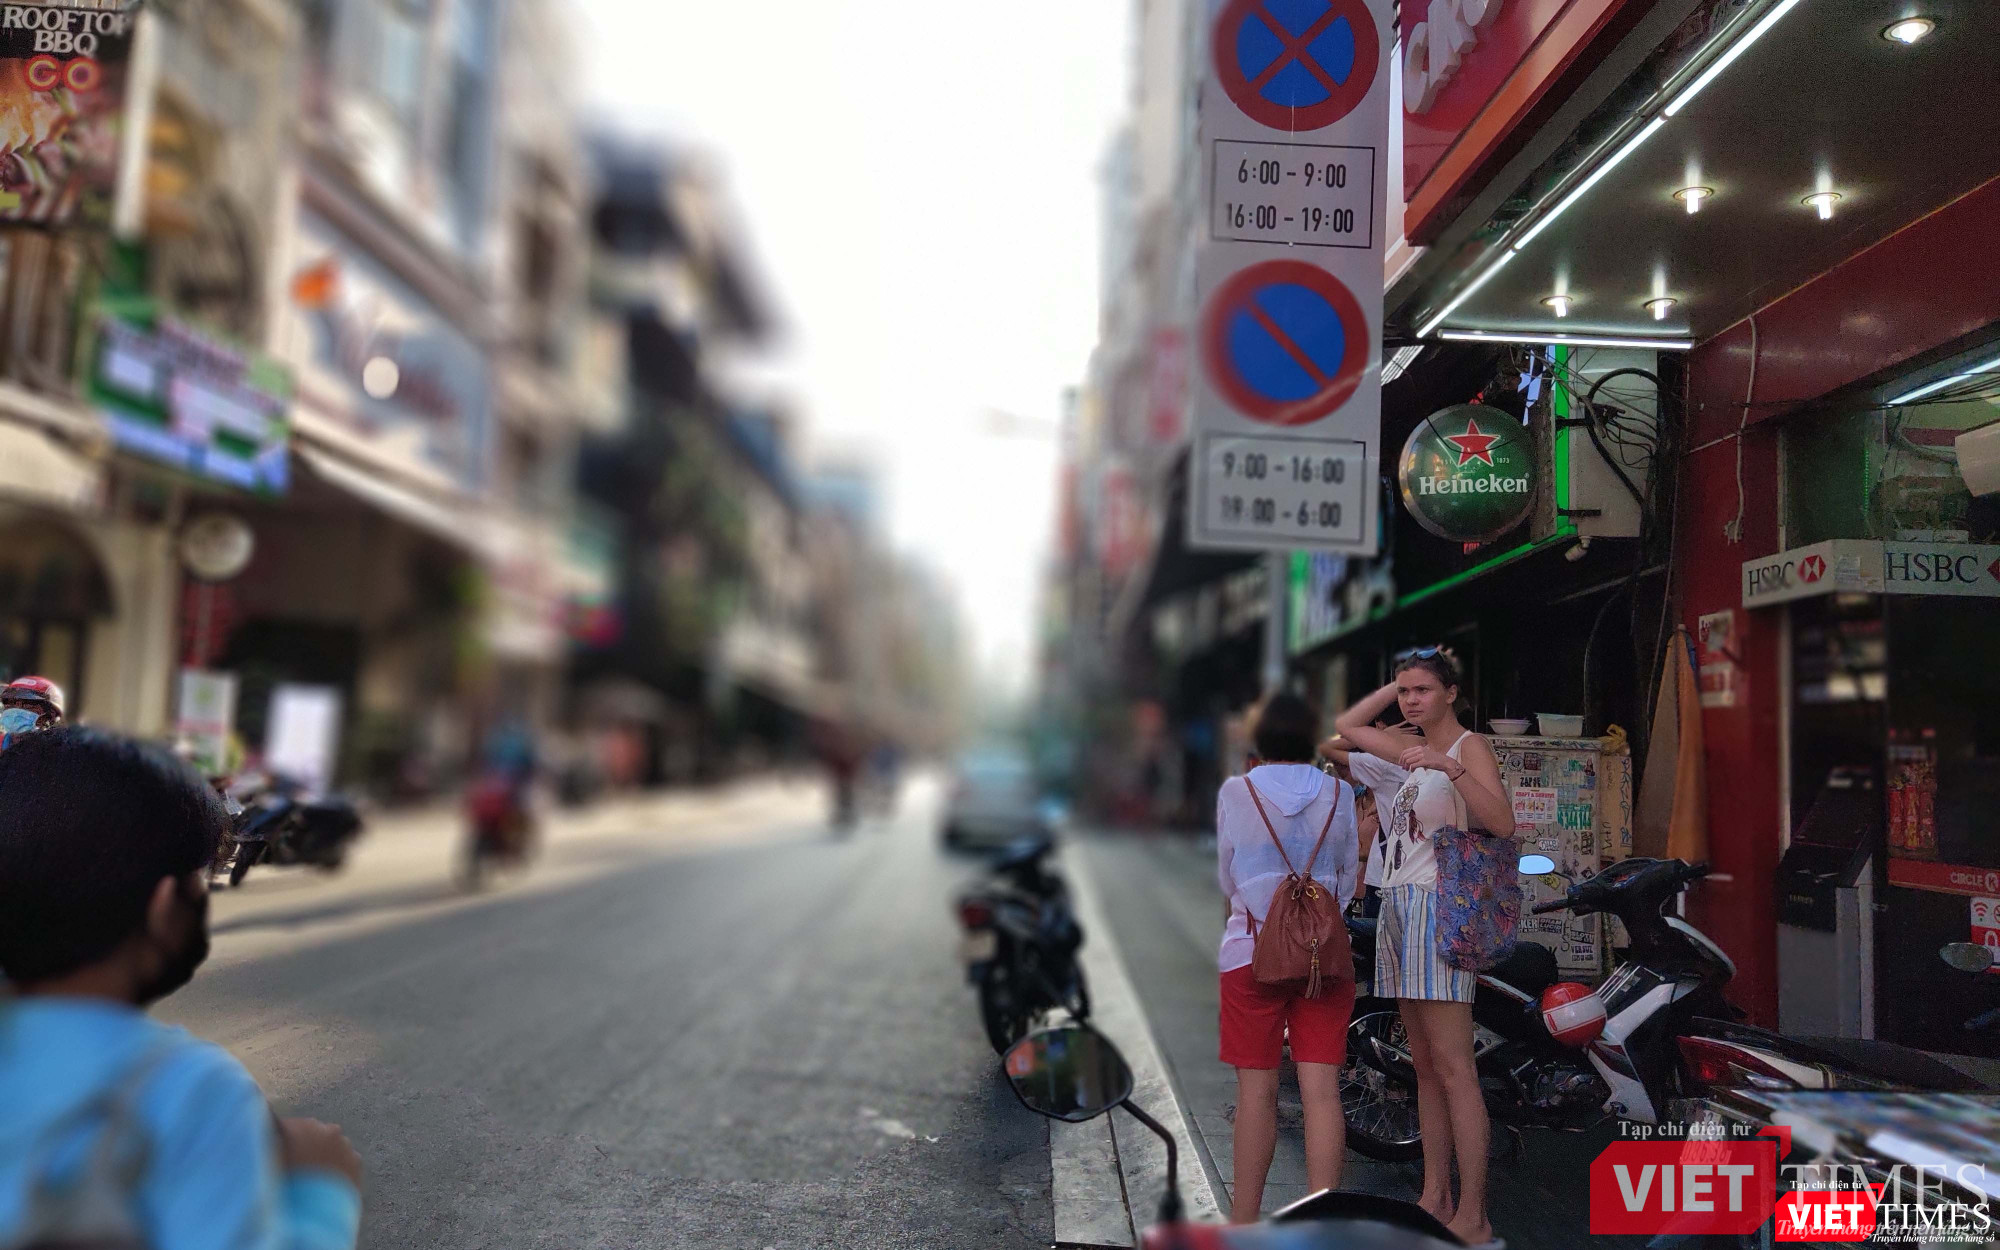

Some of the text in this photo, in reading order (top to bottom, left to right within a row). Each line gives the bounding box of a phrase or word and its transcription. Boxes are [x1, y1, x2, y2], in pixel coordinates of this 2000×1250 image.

[34, 30, 97, 58] BBQ
[1238, 159, 1280, 185] 6:00
[1304, 162, 1347, 188] 9:00
[1227, 203, 1277, 229] 16:00
[1302, 207, 1354, 233] 19:00
[1223, 452, 1267, 479] 9:00
[1292, 456, 1345, 484] 16:00
[1419, 473, 1528, 495] Heineken
[1297, 501, 1342, 528] 6:00
[1886, 552, 1980, 583] HSBC
[1950, 871, 1983, 886] CIRCLE
